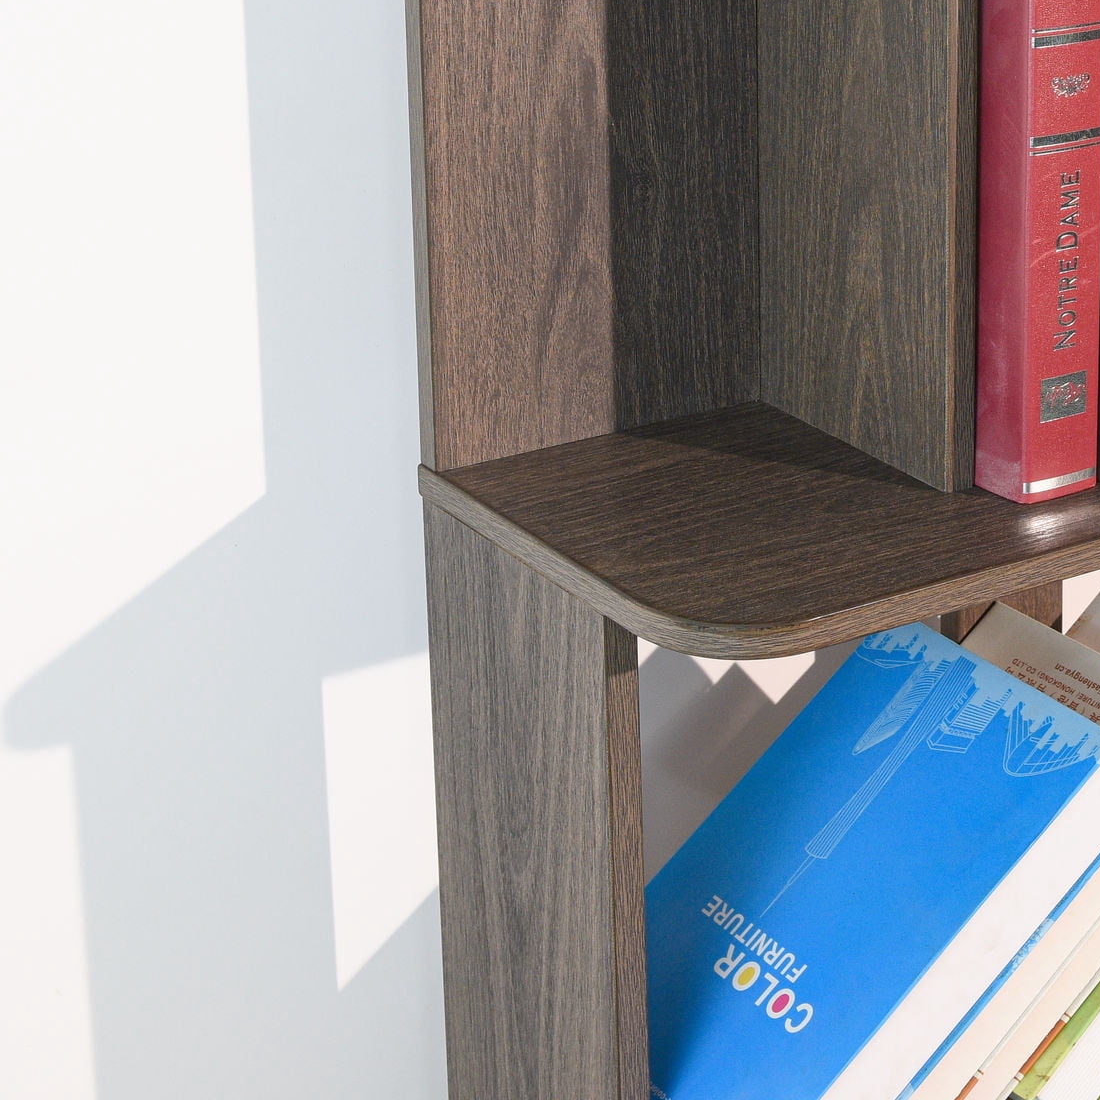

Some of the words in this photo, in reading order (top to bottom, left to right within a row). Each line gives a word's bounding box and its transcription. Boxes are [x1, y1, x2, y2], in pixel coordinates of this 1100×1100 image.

[1056, 169, 1081, 253] DAME
[1053, 255, 1080, 352] NOTRE
[701, 894, 808, 983] FURNITURE
[713, 943, 814, 1034] COLOR
